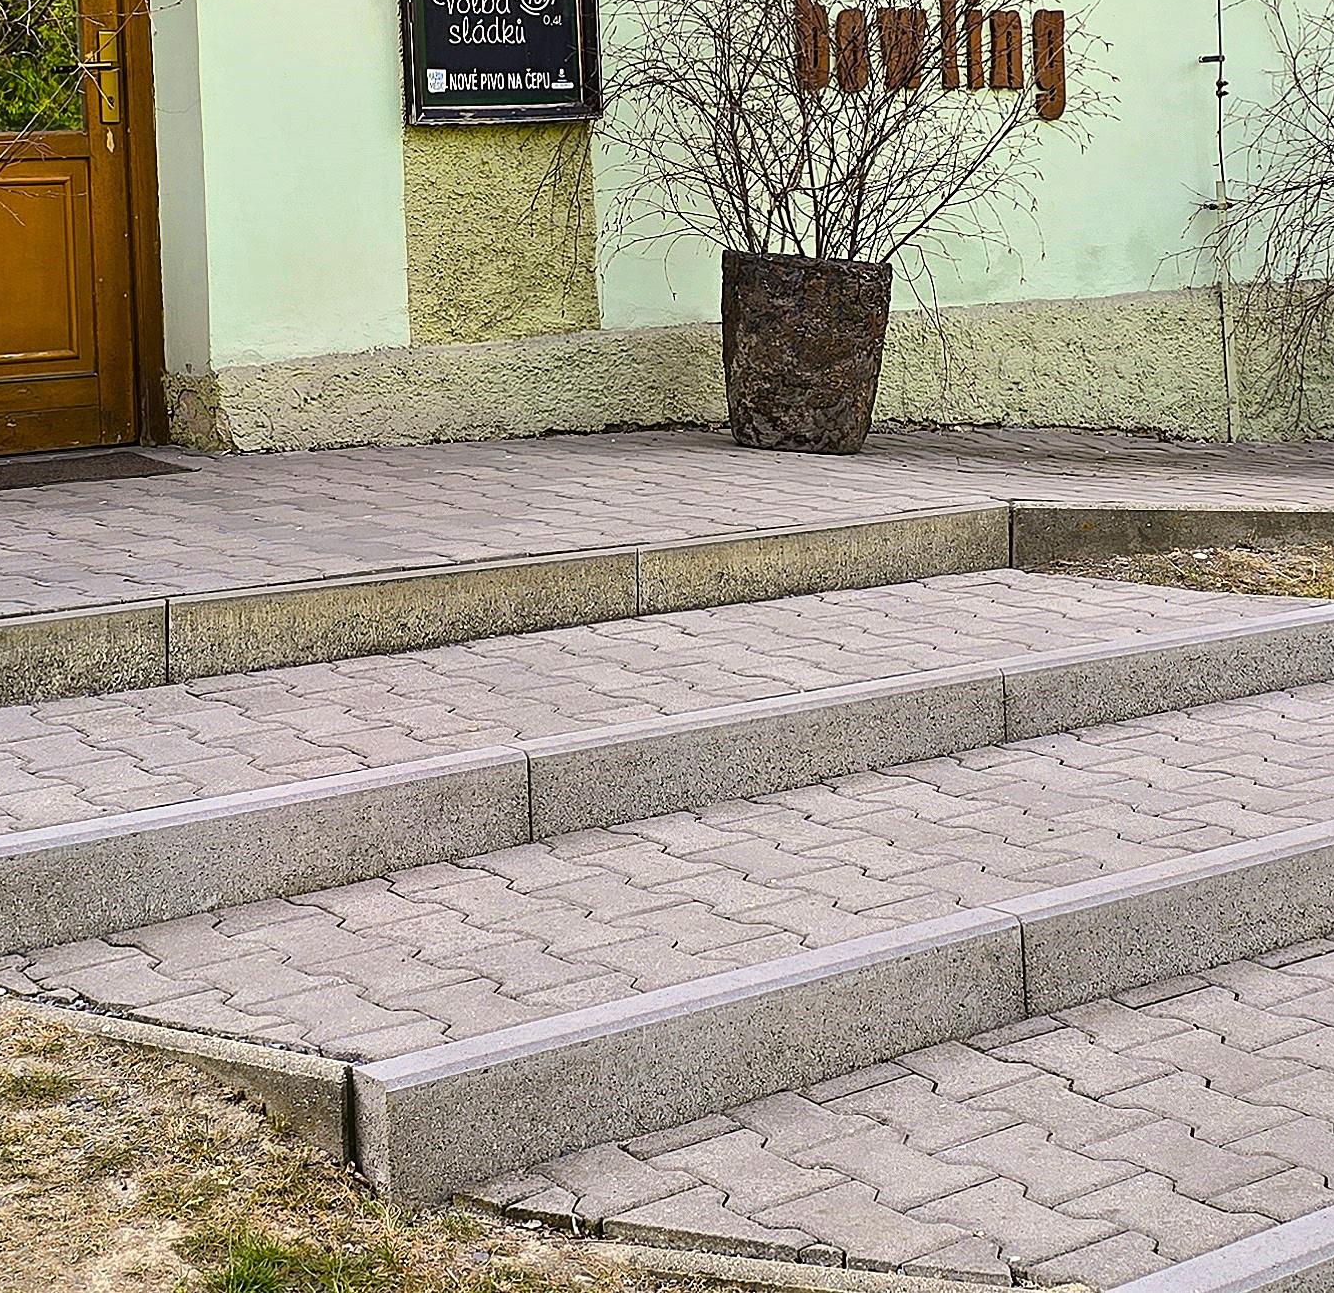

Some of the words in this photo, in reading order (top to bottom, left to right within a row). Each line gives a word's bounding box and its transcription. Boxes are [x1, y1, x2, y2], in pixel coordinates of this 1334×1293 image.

[448, 15, 527, 45] sládků
[449, 68, 479, 91] NOVÉ
[480, 72, 505, 91] PIVO
[507, 71, 524, 90] NA
[524, 67, 551, 90] ČEPU
